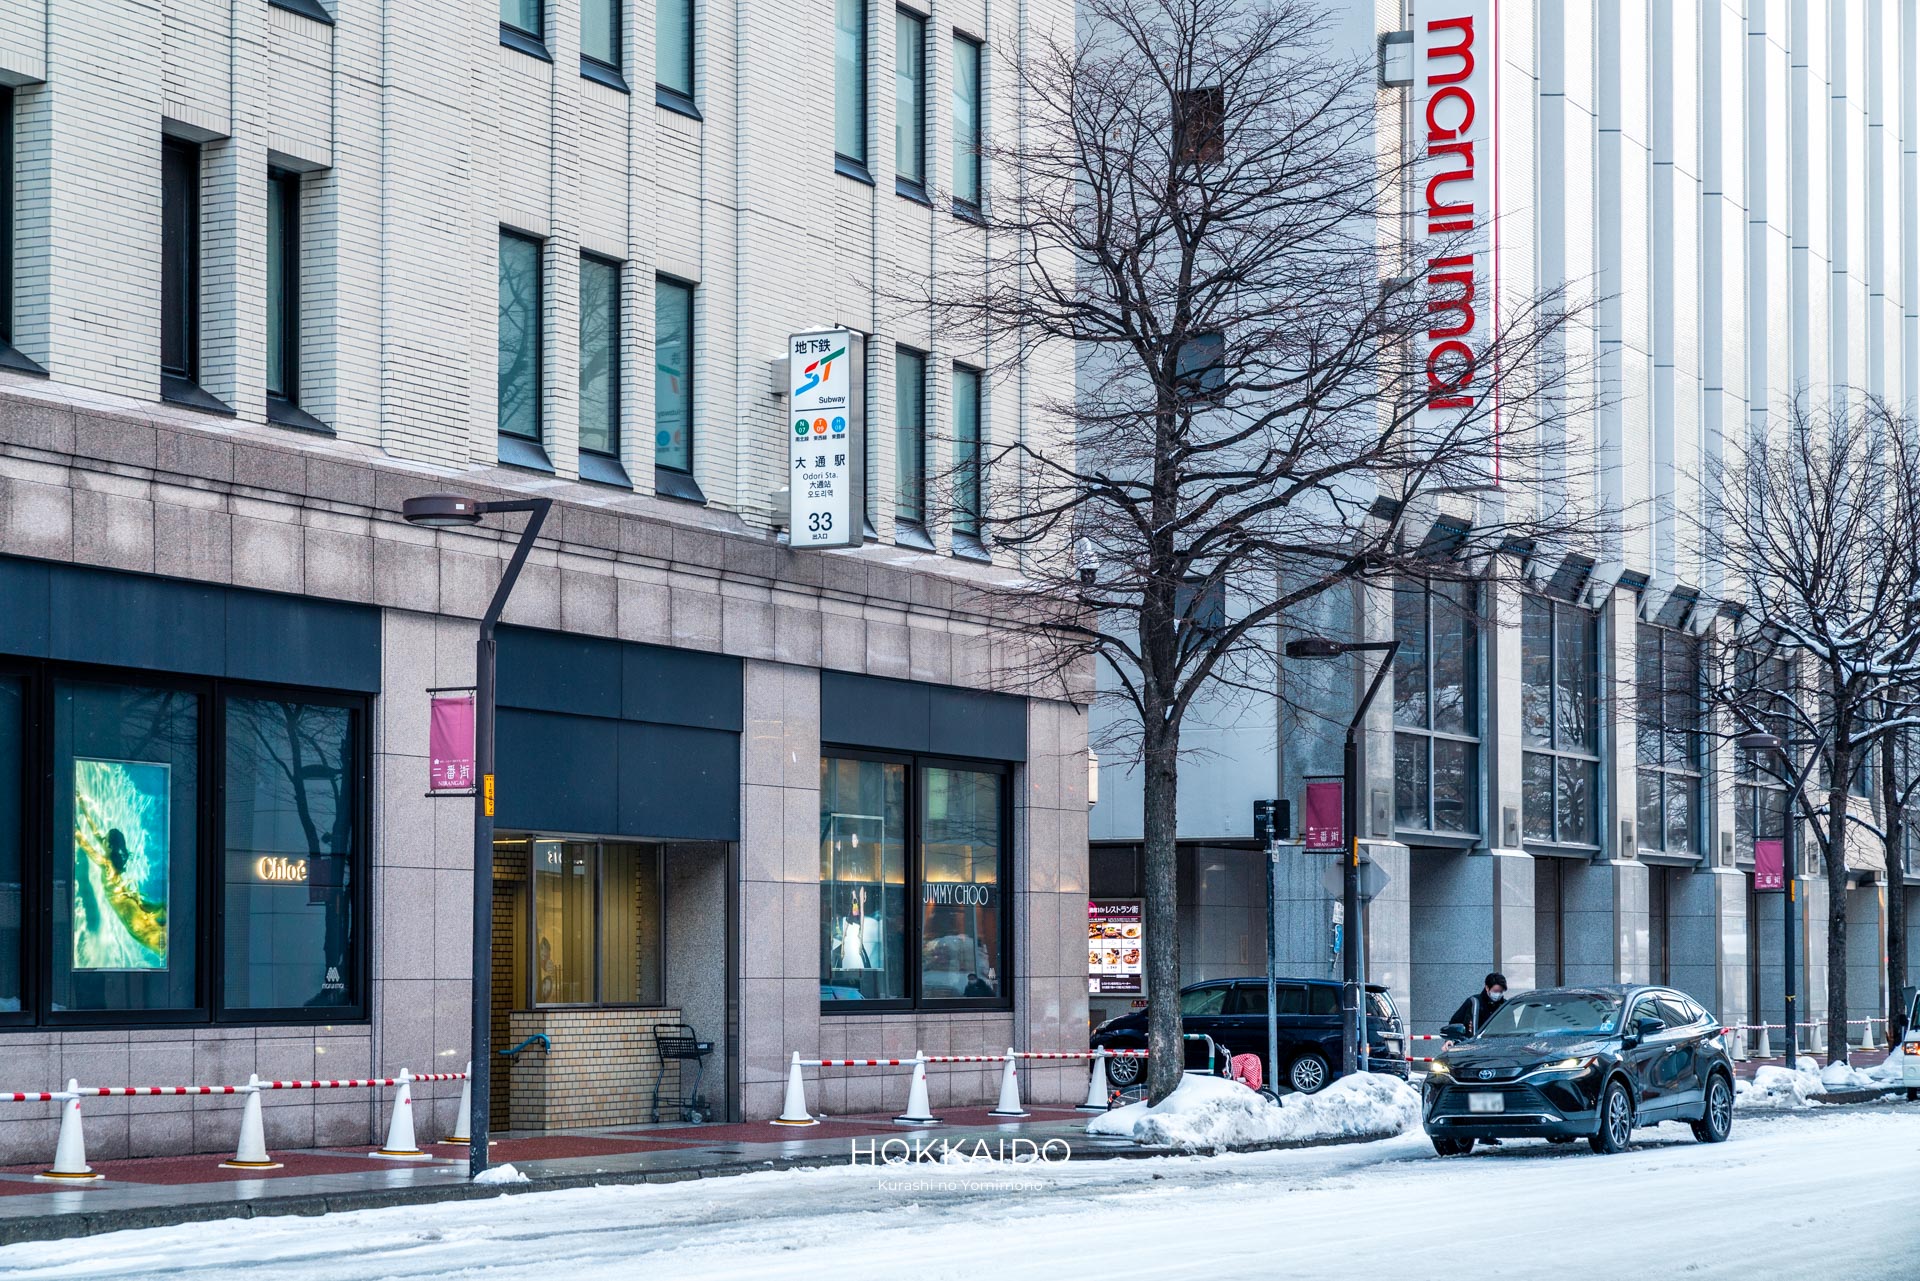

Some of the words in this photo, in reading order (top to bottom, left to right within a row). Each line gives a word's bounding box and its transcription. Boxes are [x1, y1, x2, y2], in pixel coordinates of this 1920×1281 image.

[795, 338, 831, 354] 地下鉄
[818, 395, 846, 404] Subway
[795, 454, 846, 469] 大通駅
[803, 472, 823, 480] Odori
[825, 471, 839, 479] Sta.
[807, 489, 834, 498] 오도리역
[808, 512, 833, 531] 33
[432, 764, 470, 779] 二番街
[1308, 831, 1339, 842] 二番街
[258, 856, 308, 881] Chloé
[922, 883, 953, 904] JIMMY
[954, 884, 989, 906] CHOO
